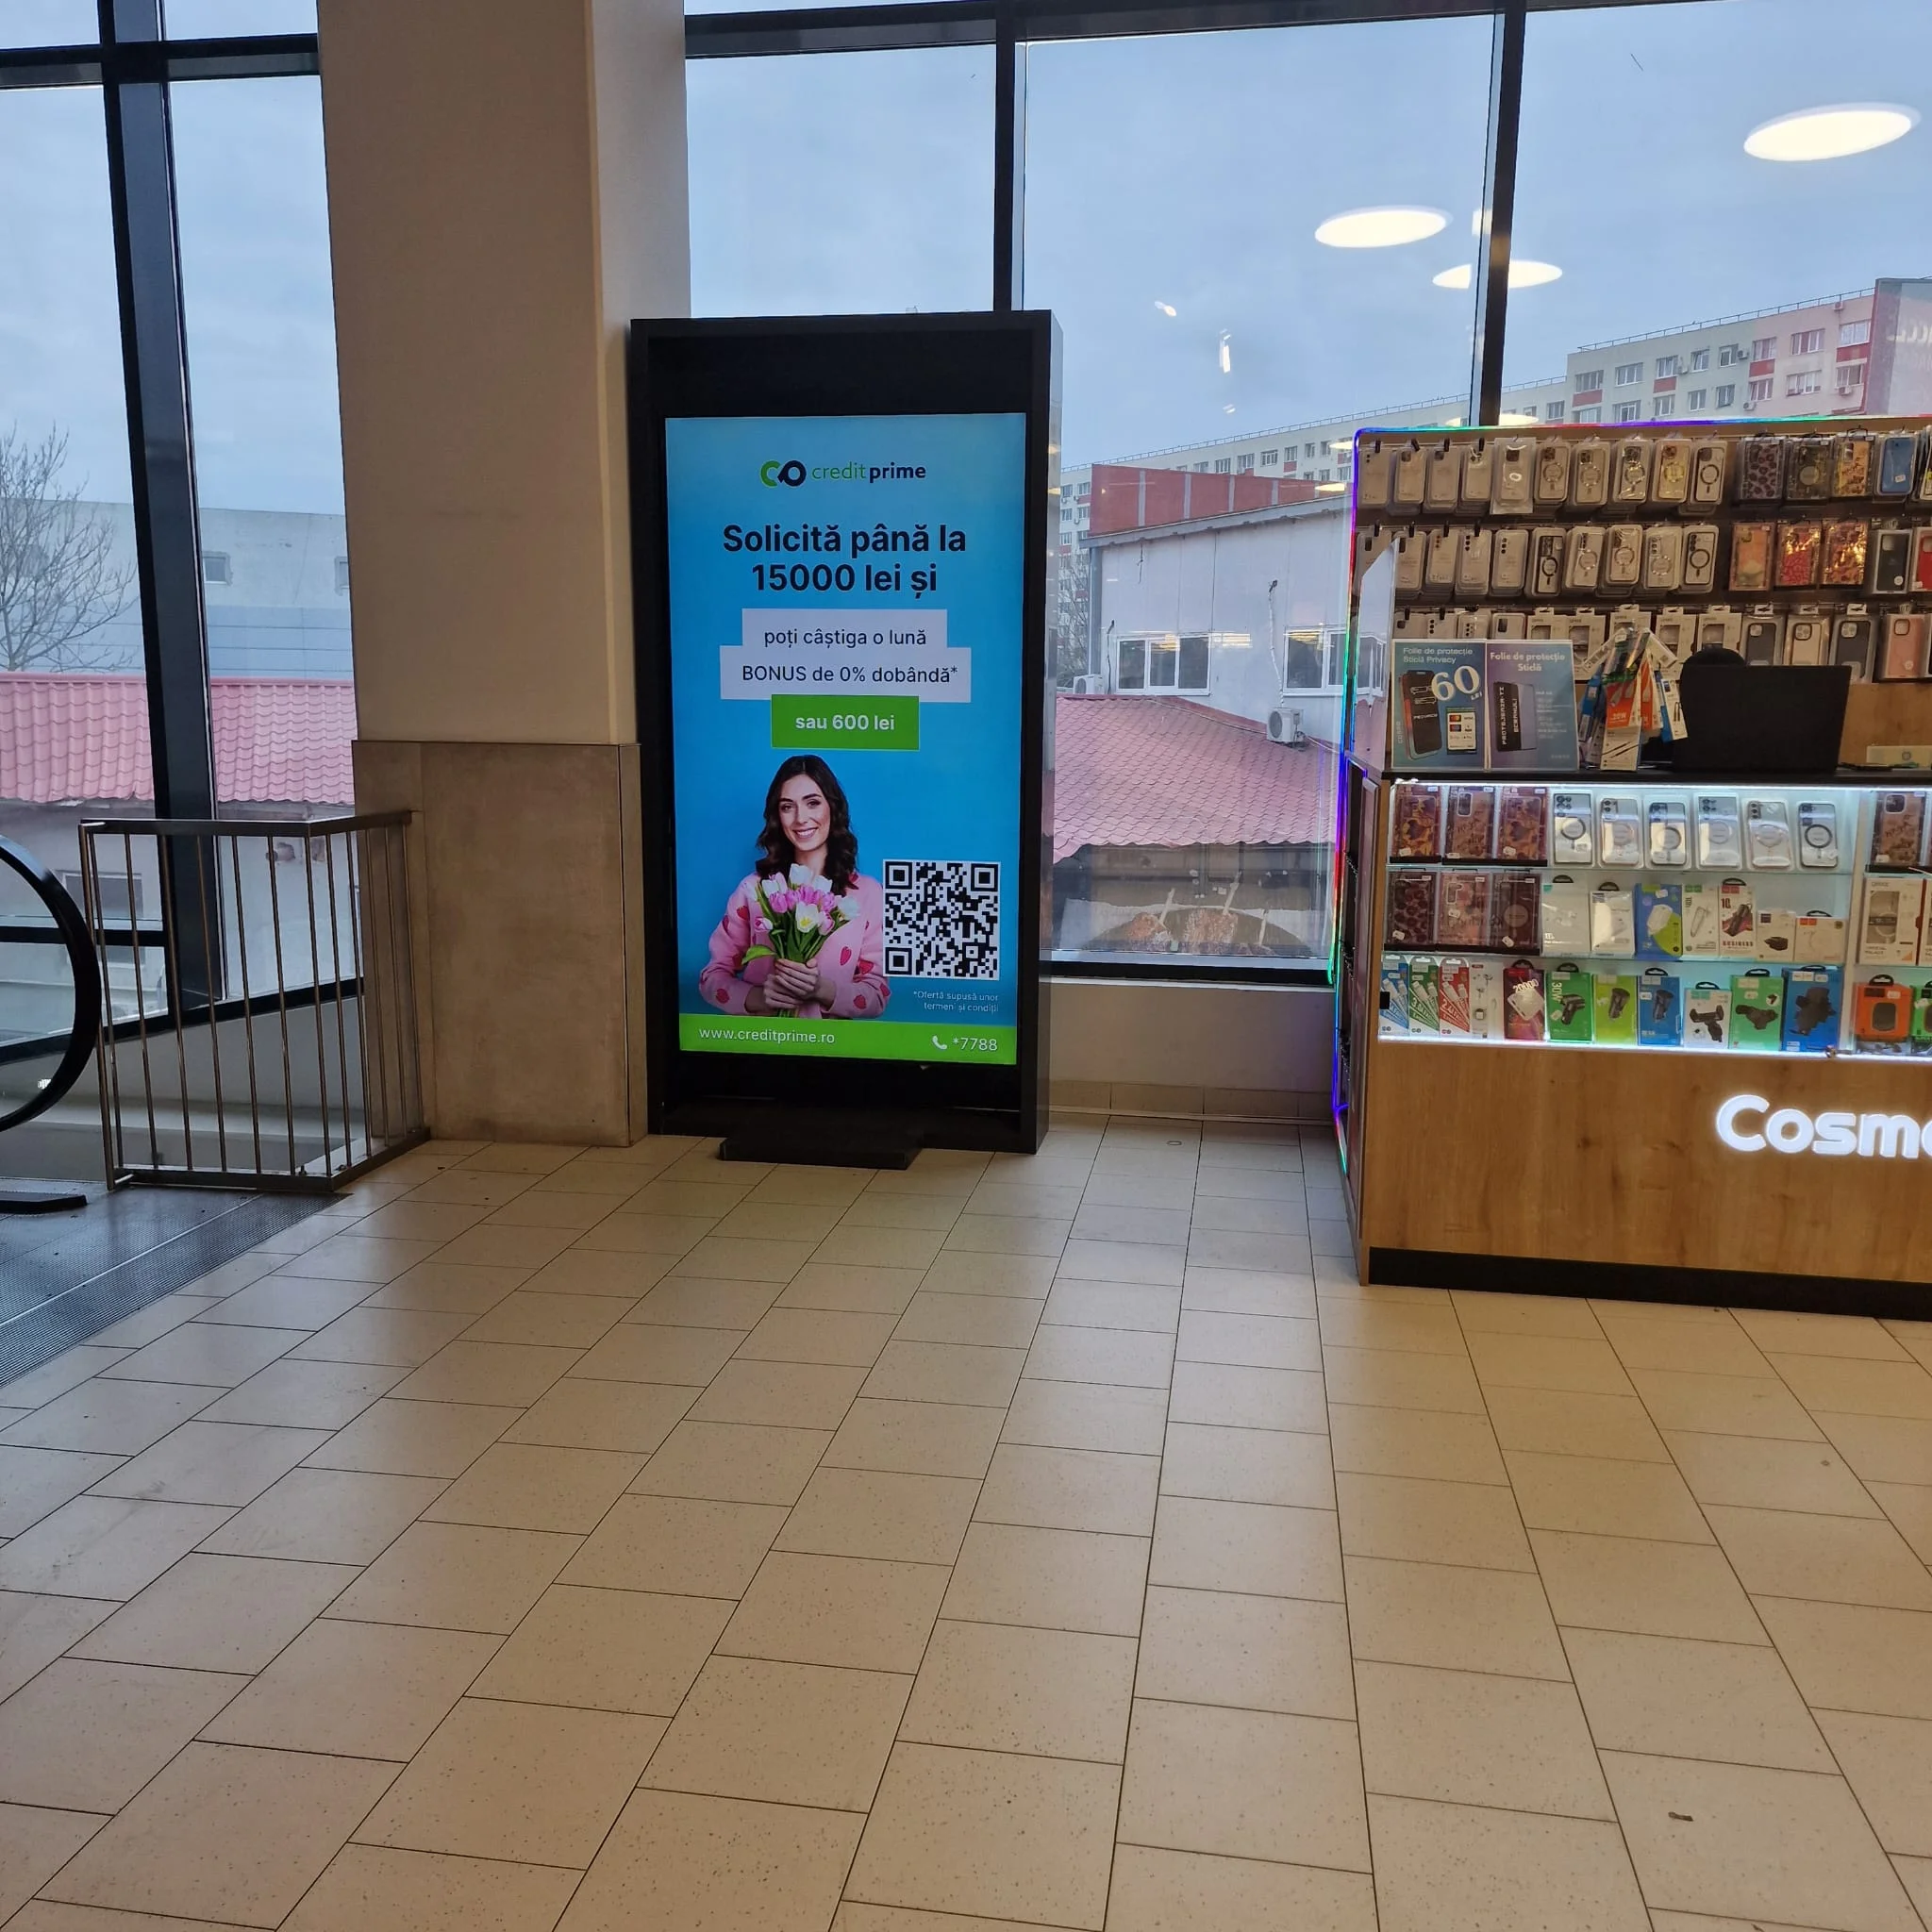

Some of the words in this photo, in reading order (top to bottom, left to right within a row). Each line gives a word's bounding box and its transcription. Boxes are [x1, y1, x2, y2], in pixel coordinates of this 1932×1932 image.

[812, 461, 926, 483] creditprime
[723, 524, 841, 552] Solicită
[851, 524, 930, 558] până
[940, 525, 966, 552] la
[751, 564, 855, 591] 15000
[865, 563, 901, 591] lei
[910, 563, 938, 598] și
[764, 629, 798, 648] poți
[803, 629, 867, 648] câștiga
[873, 634, 884, 645] o
[889, 630, 926, 645] lună
[1426, 656, 1457, 664] Privacy
[1491, 652, 1511, 660] Folie
[1514, 652, 1524, 660] de
[741, 666, 807, 682] BONUS
[812, 666, 834, 681] de
[840, 667, 866, 683] 0%
[1431, 665, 1481, 701] 60
[795, 717, 827, 730] sau
[832, 715, 869, 730] 600
[874, 715, 895, 731] lei
[1512, 978, 1540, 993] 20000
[946, 992, 977, 1002] supusă
[698, 1027, 836, 1044] www.creditprime.ro
[1716, 1094, 1932, 1159] Cosm
